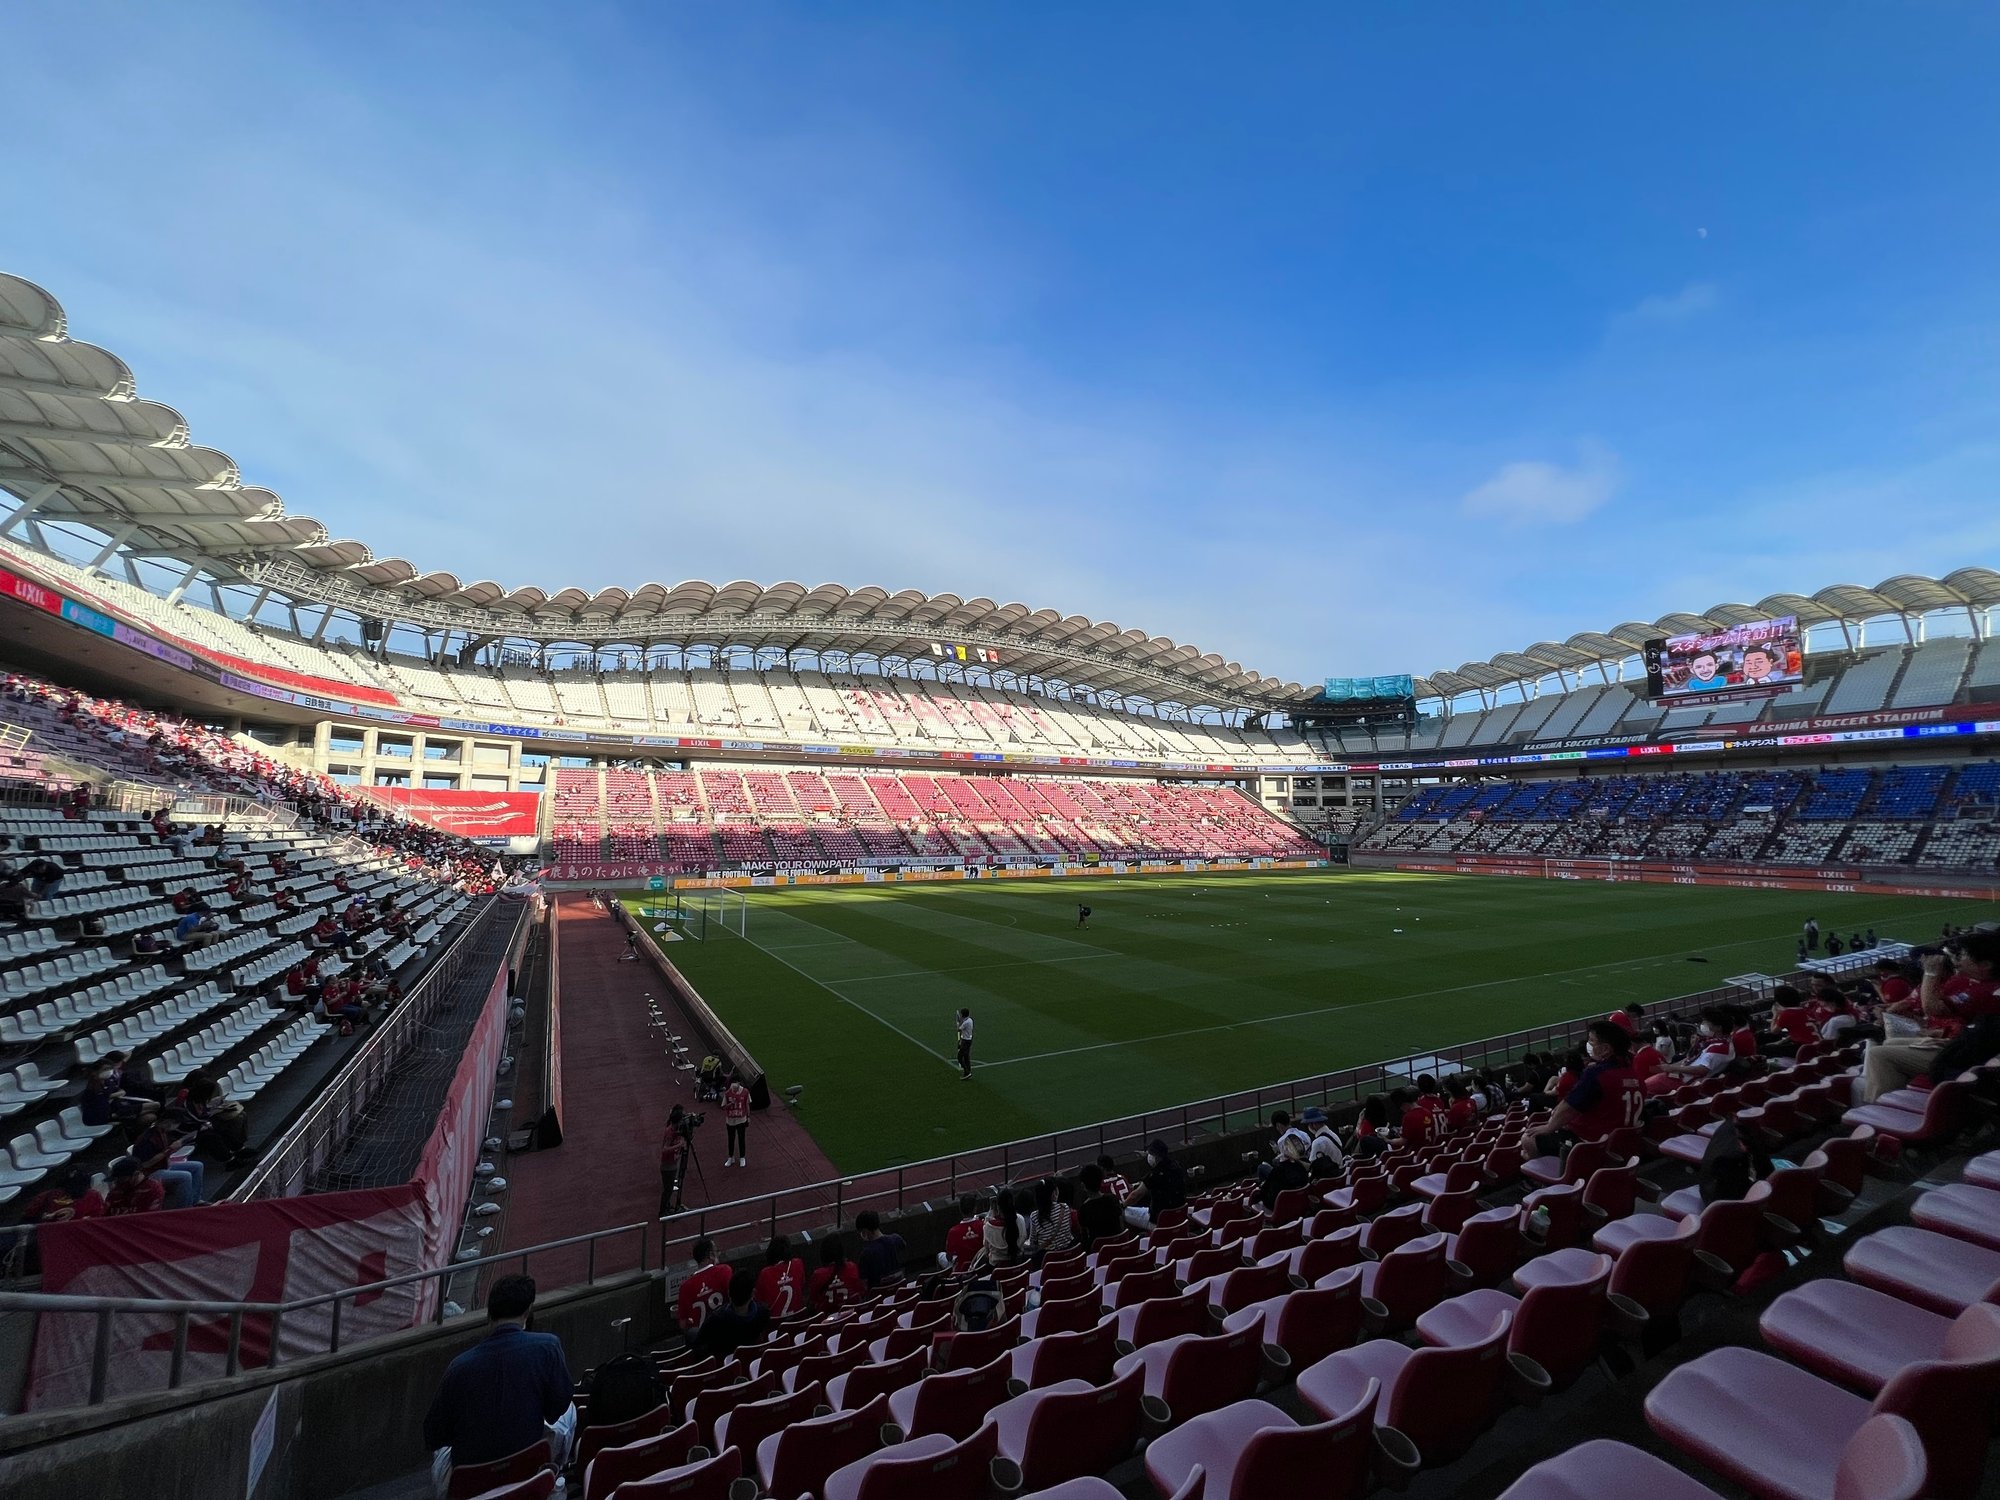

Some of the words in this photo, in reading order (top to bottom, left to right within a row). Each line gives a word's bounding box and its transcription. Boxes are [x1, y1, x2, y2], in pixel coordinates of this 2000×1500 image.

[15, 580, 46, 606] LIXIL
[305, 697, 332, 710] 日鉄物流
[1748, 720, 1809, 734] KASHIMA
[1812, 716, 1869, 728] SOCCER
[1872, 709, 1944, 723] STADIUM
[505, 727, 536, 736] ヤマイチ
[1522, 740, 1562, 750] KASHIMA
[1564, 738, 1602, 748] SOCCER
[1602, 734, 1649, 745] STADIUM
[1640, 746, 1662, 754] LIXIL
[741, 861, 773, 870] MAKE
[773, 860, 803, 870] YOUR
[803, 860, 829, 869] OWN
[829, 859, 856, 868] PATH
[722, 870, 751, 878] FOOTBALL
[790, 868, 818, 876] FOOTBALL
[853, 867, 878, 875] FOOTBALL
[1817, 871, 1846, 879] LIXIL
[1826, 884, 1856, 892] LIXIL
[1621, 1090, 1645, 1127] 12
[1432, 1112, 1448, 1137] 18
